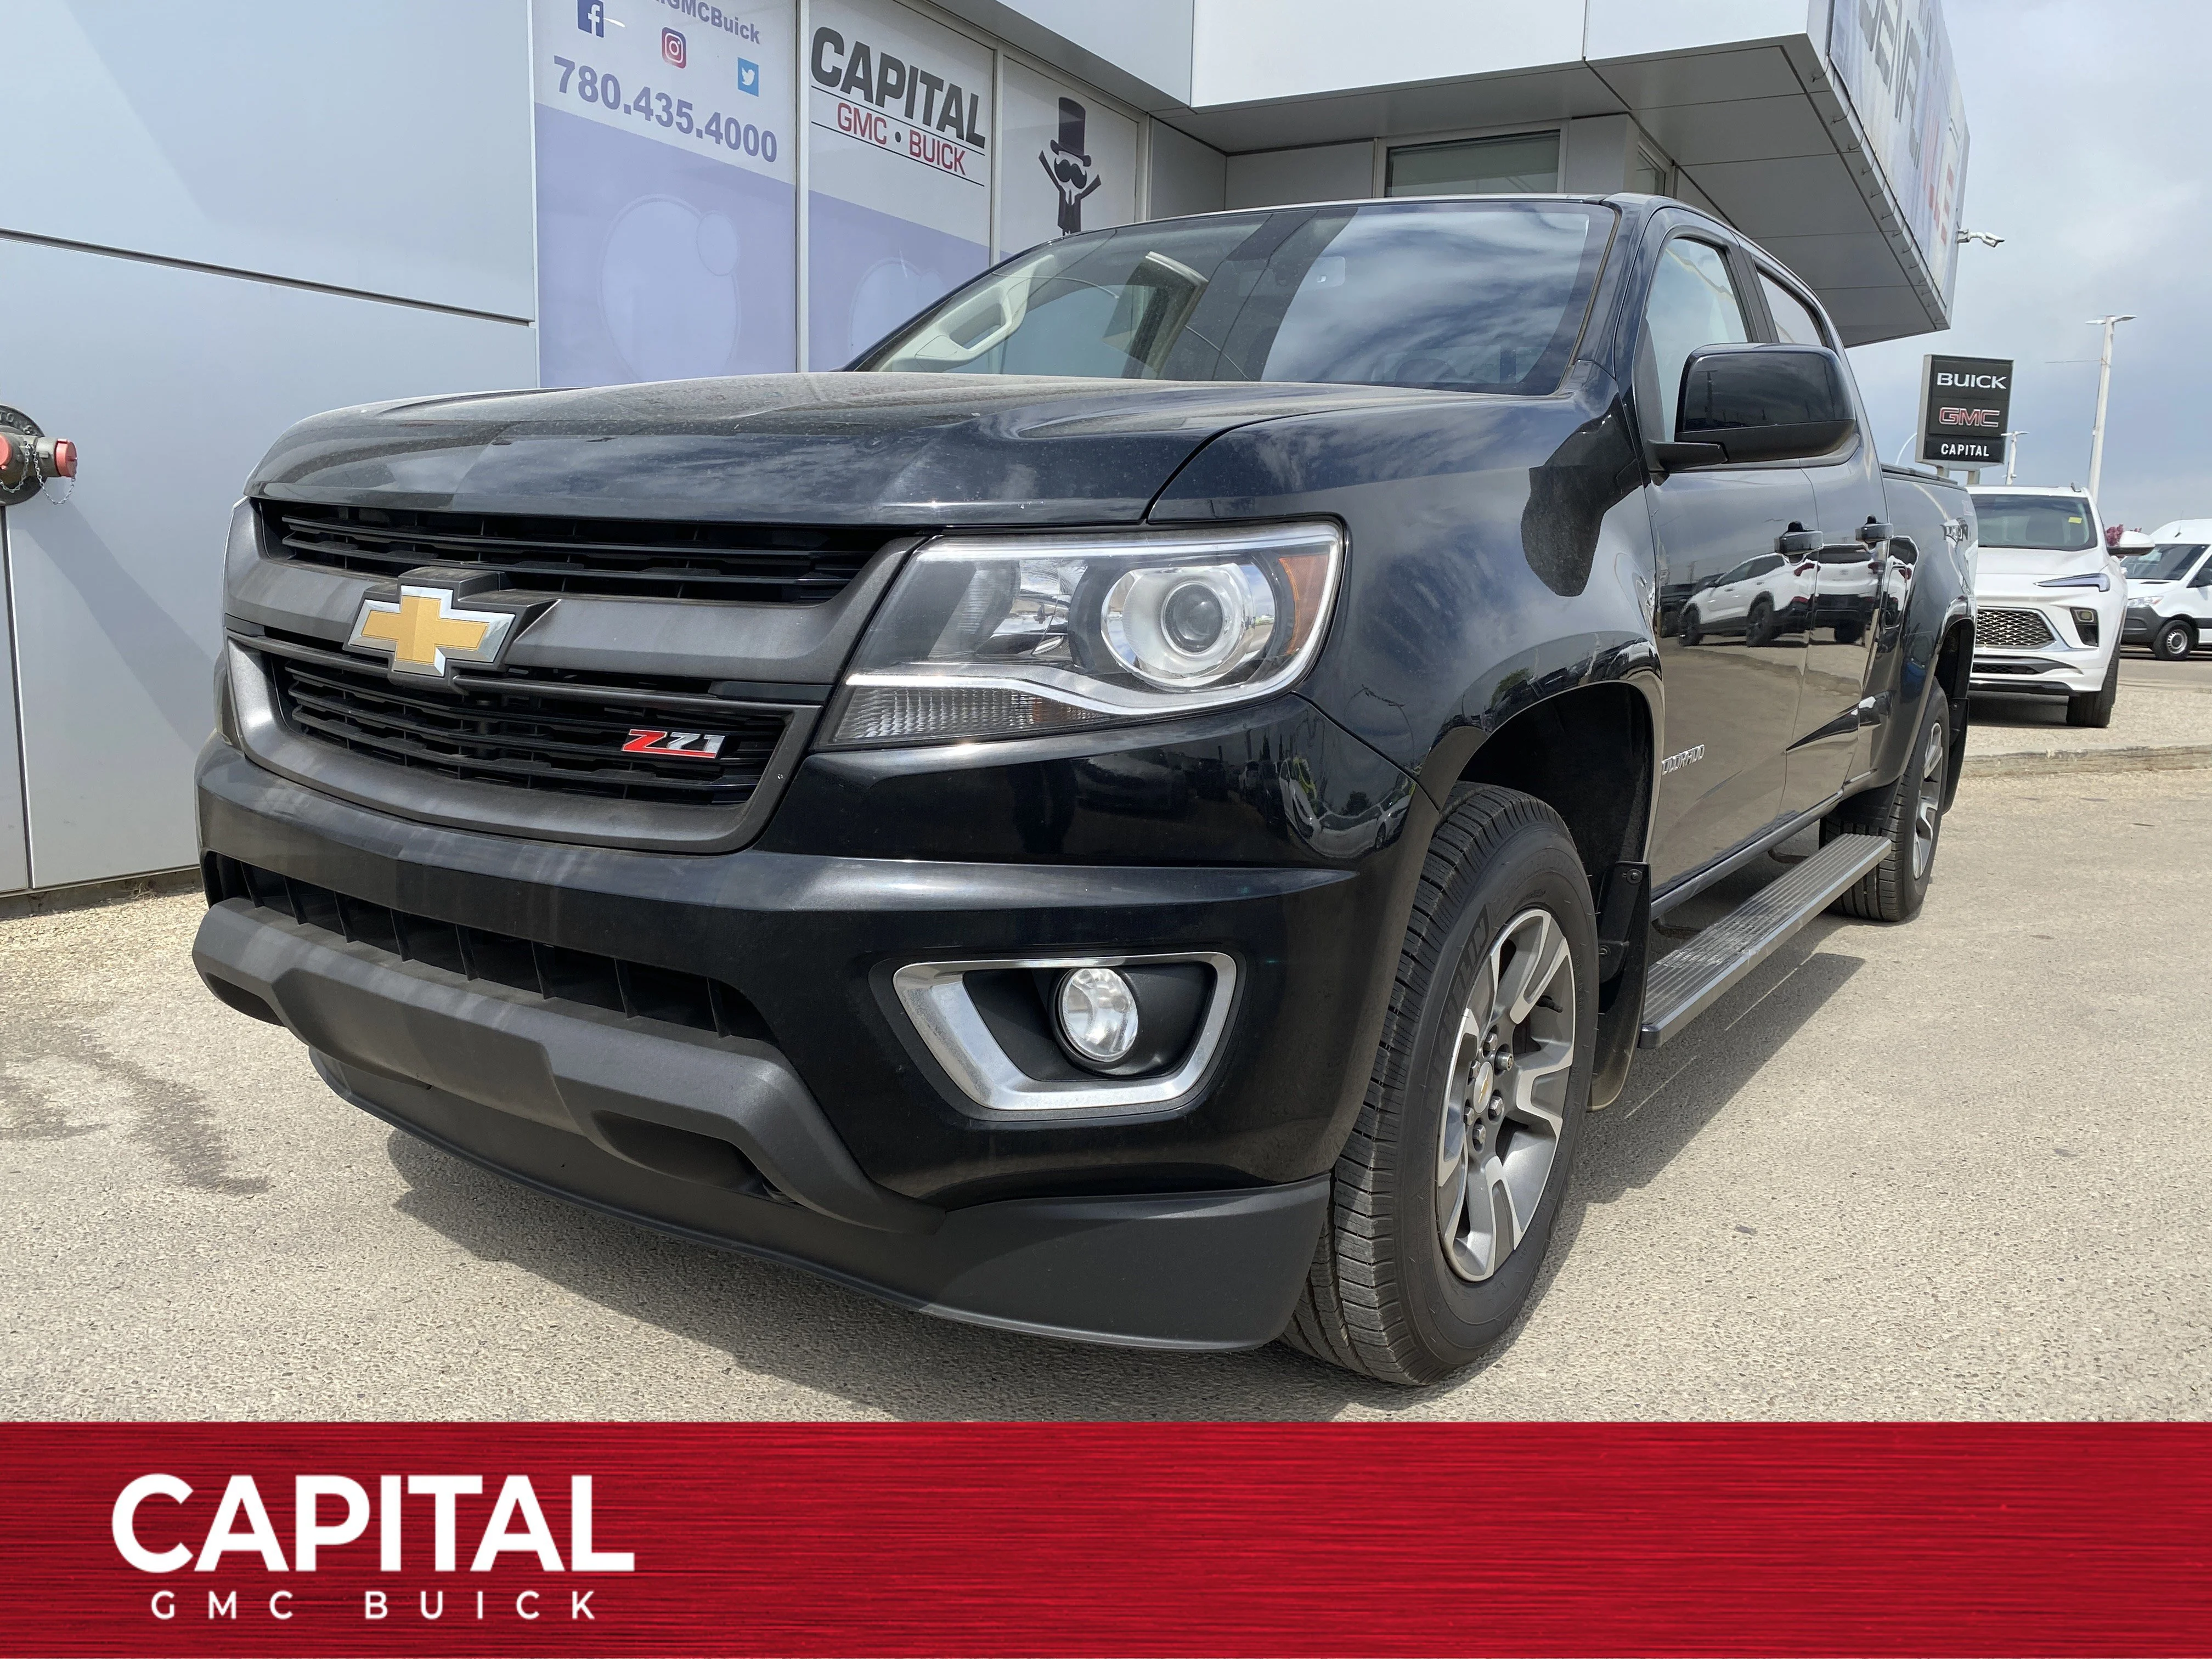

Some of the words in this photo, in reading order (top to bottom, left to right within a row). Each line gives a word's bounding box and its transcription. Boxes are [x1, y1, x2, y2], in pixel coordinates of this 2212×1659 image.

[656, 0, 760, 44] GMCBuick
[811, 26, 985, 149] CAPITAL
[554, 55, 777, 162] 780.435.4000
[837, 103, 887, 145] GMC
[910, 129, 966, 176] BUICK
[1937, 373, 2007, 390] BUICK
[1939, 407, 2000, 428] GMC
[1940, 443, 1990, 457] CAPITAL
[621, 729, 725, 759] Z71
[1662, 744, 1705, 776] OLORADO
